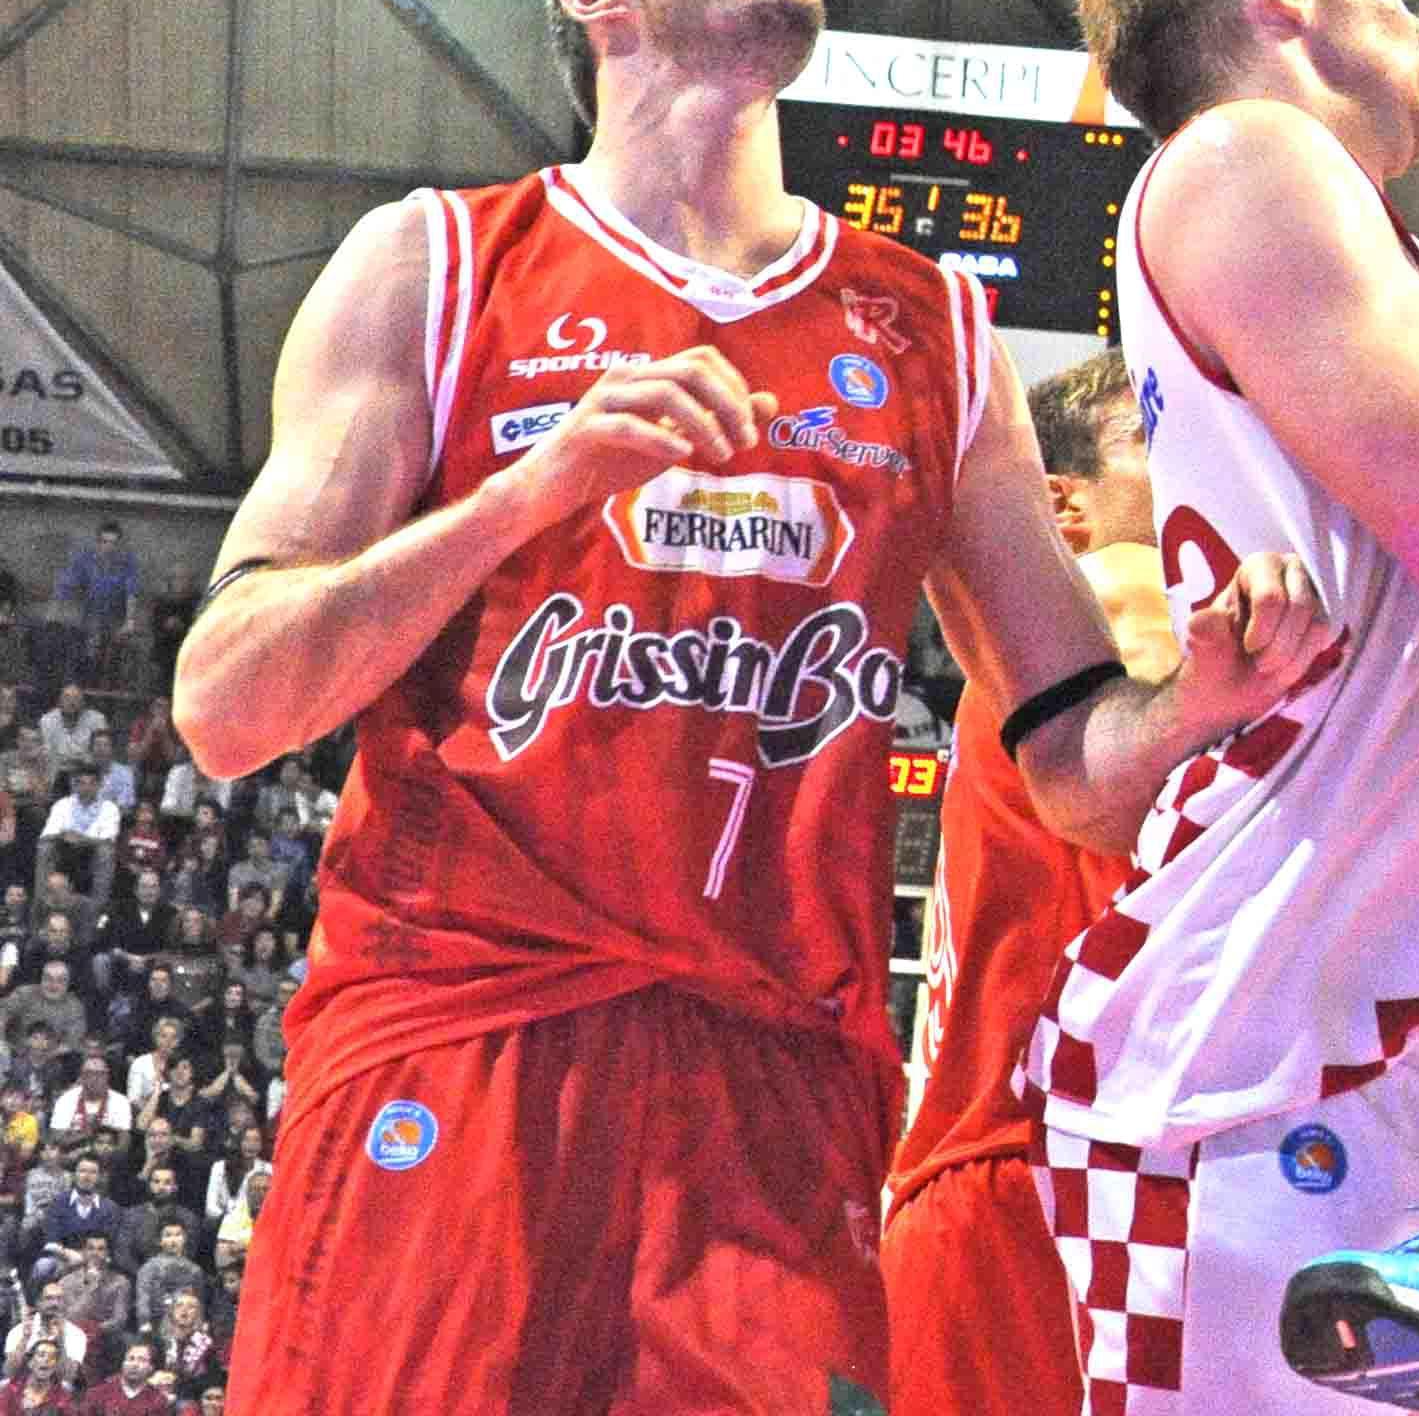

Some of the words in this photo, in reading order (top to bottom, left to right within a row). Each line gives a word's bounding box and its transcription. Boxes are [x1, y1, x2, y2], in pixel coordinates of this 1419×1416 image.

[0, 368, 85, 402] AS
[643, 508, 814, 561] FERRARINI
[486, 593, 904, 770] GrissinBo
[703, 758, 756, 900] 7
